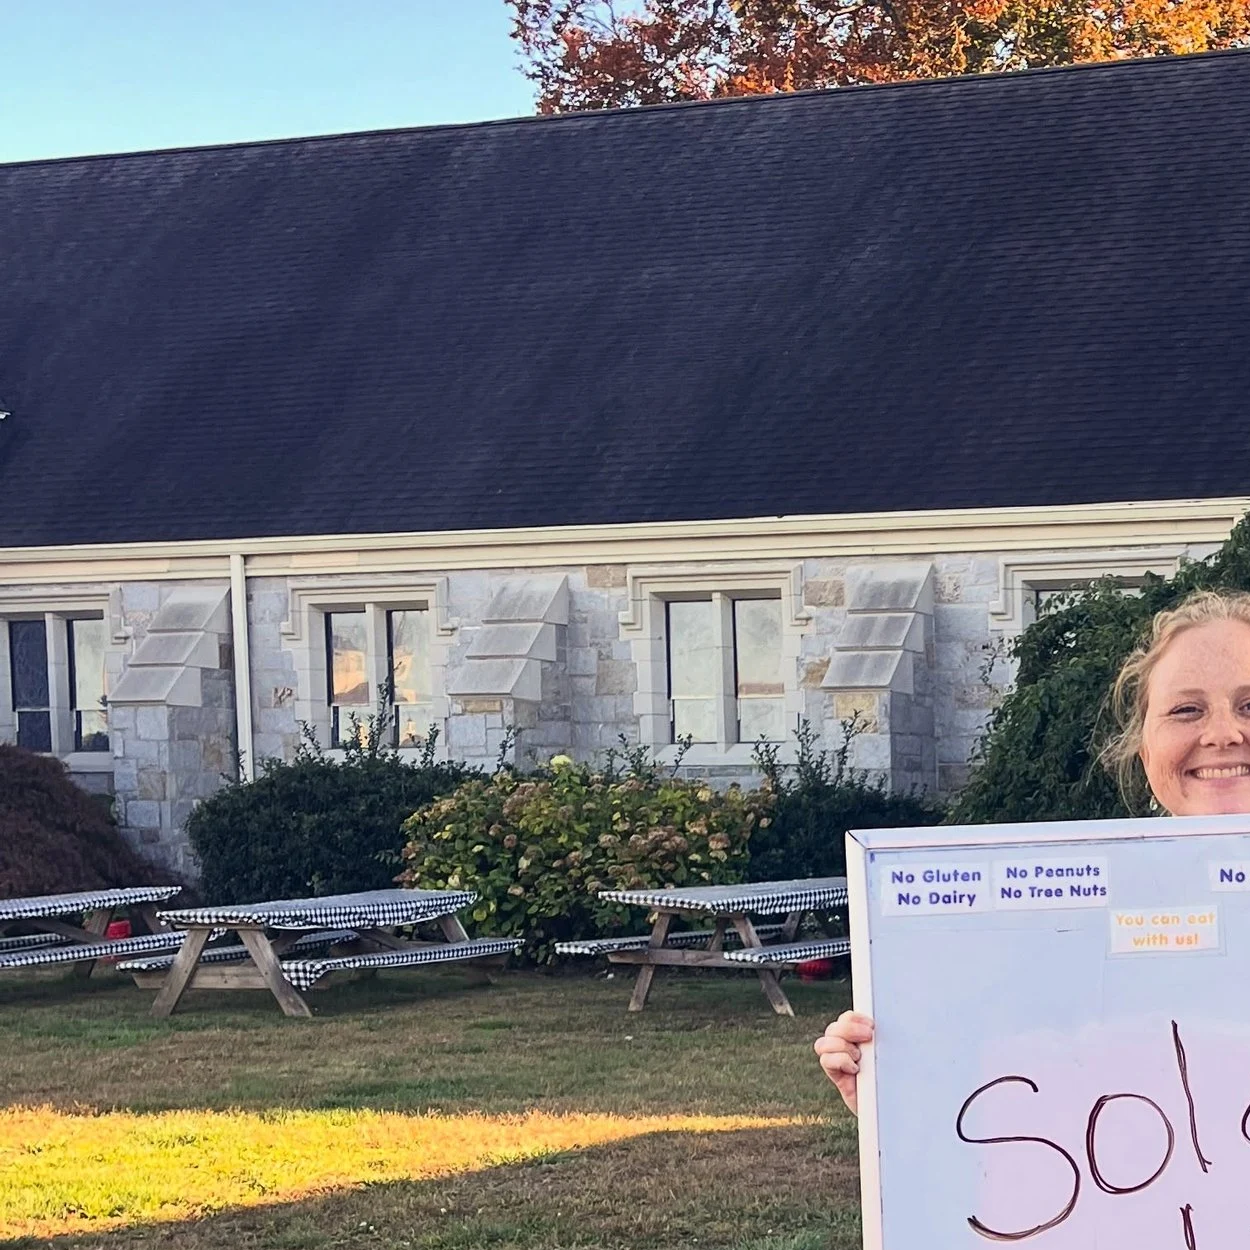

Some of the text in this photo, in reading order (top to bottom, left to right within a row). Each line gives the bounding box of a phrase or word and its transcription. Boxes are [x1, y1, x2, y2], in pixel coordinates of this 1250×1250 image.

[891, 869, 982, 884] No Gluten
[1006, 864, 1100, 879] No Peanuts
[1219, 868, 1246, 883] No
[898, 890, 977, 907] No Dairy
[1000, 884, 1107, 899] No Tree Nuts
[1116, 912, 1216, 926] You can eat
[1132, 932, 1198, 946] with us!
